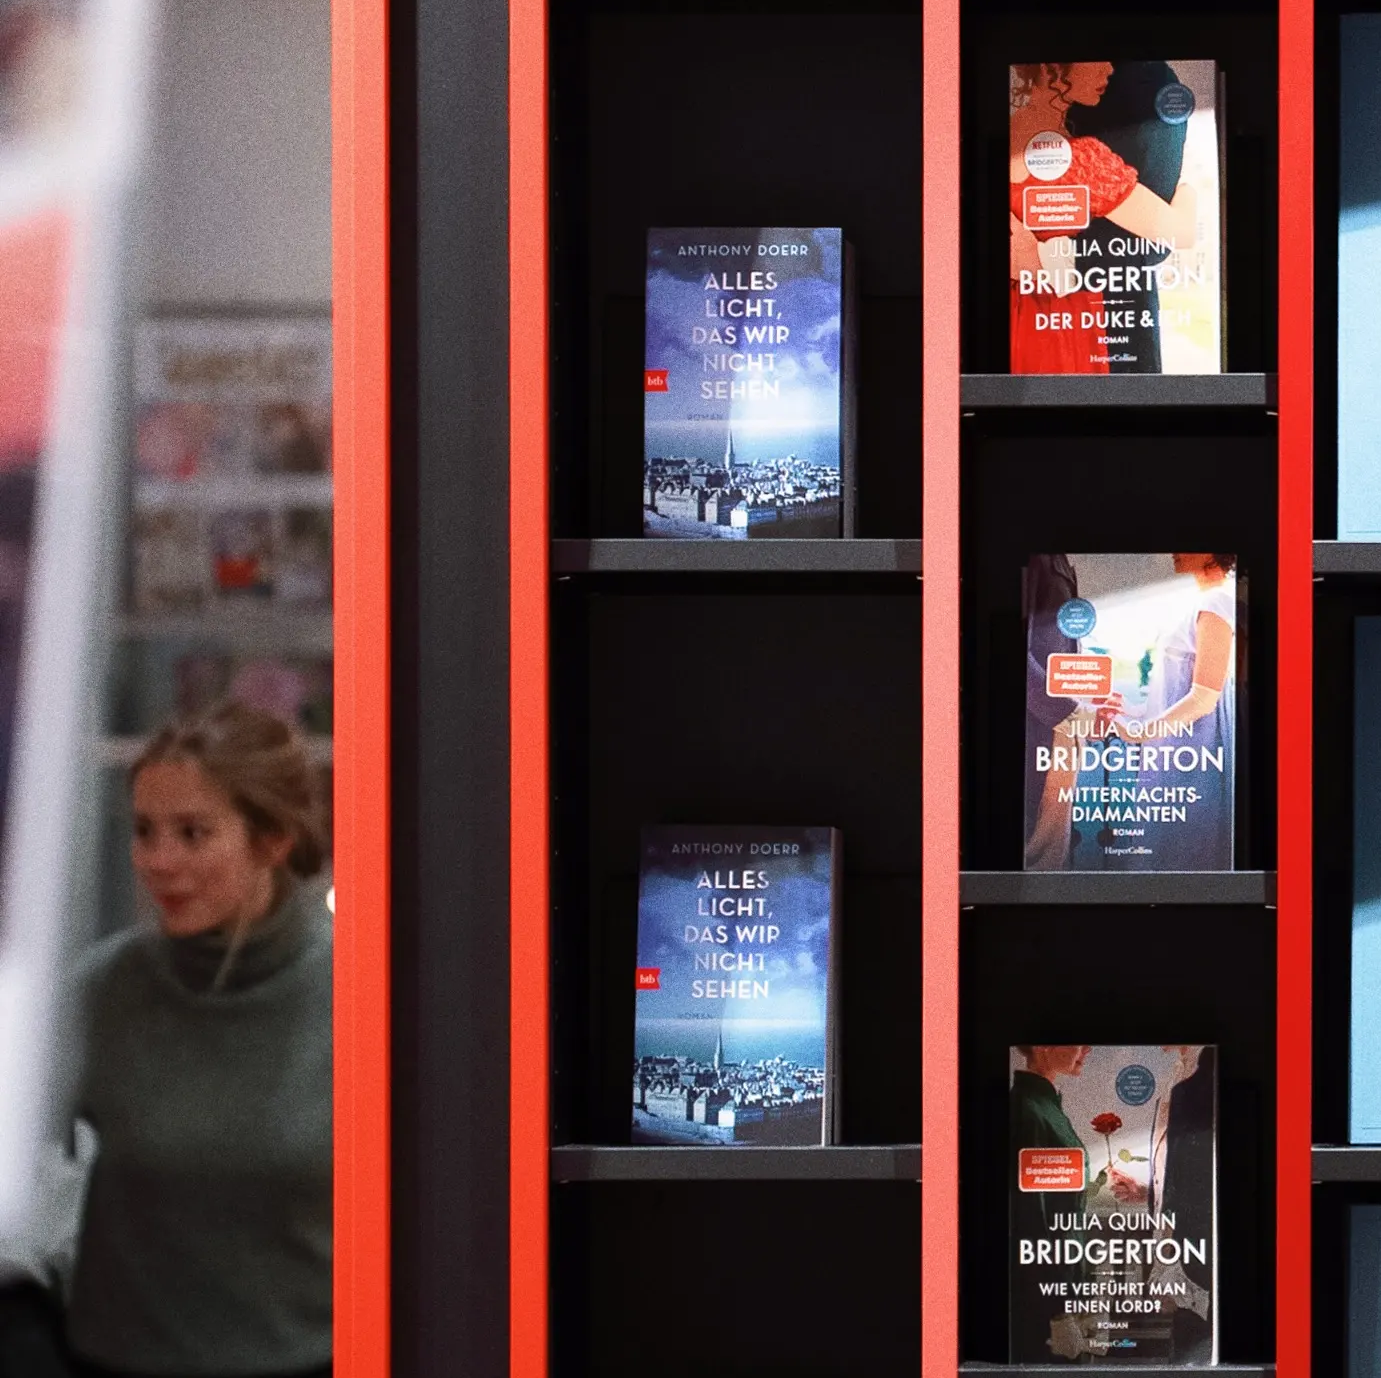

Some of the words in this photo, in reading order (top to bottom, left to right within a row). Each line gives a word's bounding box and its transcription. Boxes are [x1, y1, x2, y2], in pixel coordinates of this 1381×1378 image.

[1032, 140, 1063, 150] NETFLIX
[1027, 157, 1069, 167] BRIDGERTON
[1035, 192, 1076, 202] SPIEGEL
[1038, 214, 1074, 222] Autorin
[678, 244, 751, 256] ANTHONY
[758, 244, 809, 256] DOERR
[1049, 239, 1102, 259] JULIA
[1108, 237, 1175, 256] QUINN
[704, 272, 778, 291] ALLES
[1019, 265, 1206, 294] BRIDGERTON
[706, 299, 782, 320] LICHT,
[1035, 313, 1073, 330] DER
[1081, 311, 1135, 329] DUKE
[1140, 311, 1154, 328] &
[693, 326, 736, 344] DAS
[1098, 336, 1128, 344] ROMAN
[703, 354, 775, 372] NICHT
[1090, 353, 1137, 364] HarperCollins
[647, 376, 663, 386] btb
[701, 381, 780, 400] SEHEN
[1062, 682, 1098, 691] Autorin
[1066, 721, 1120, 738] JULIA
[1126, 721, 1193, 739] QUINN
[1036, 746, 1224, 772] BRIDGERTON
[1058, 787, 1202, 803] MITTERNACHTS-
[1072, 807, 1186, 822] DIAMANTEN
[671, 843, 743, 854] ANTHONY
[750, 843, 800, 855] DOERR
[1104, 846, 1152, 855] HarperCollins
[697, 870, 769, 889] ALLES
[698, 898, 772, 918] LICHT,
[685, 925, 728, 943] DAS
[694, 953, 765, 971] NICHT
[639, 974, 655, 984] btb
[692, 980, 769, 999] SEHEN
[1034, 1176, 1070, 1185] Autorin
[1049, 1213, 1102, 1231] JULIA
[1109, 1213, 1176, 1231] QUINN
[1020, 1239, 1206, 1265] BRIDGERTON
[1039, 1283, 1067, 1295] WIE
[1072, 1280, 1144, 1295] VERFÜHRT
[1149, 1283, 1186, 1295] MAN
[1065, 1300, 1110, 1313] EINEN
[1116, 1300, 1161, 1313] LORD?
[1089, 1339, 1137, 1348] HarperCollins
